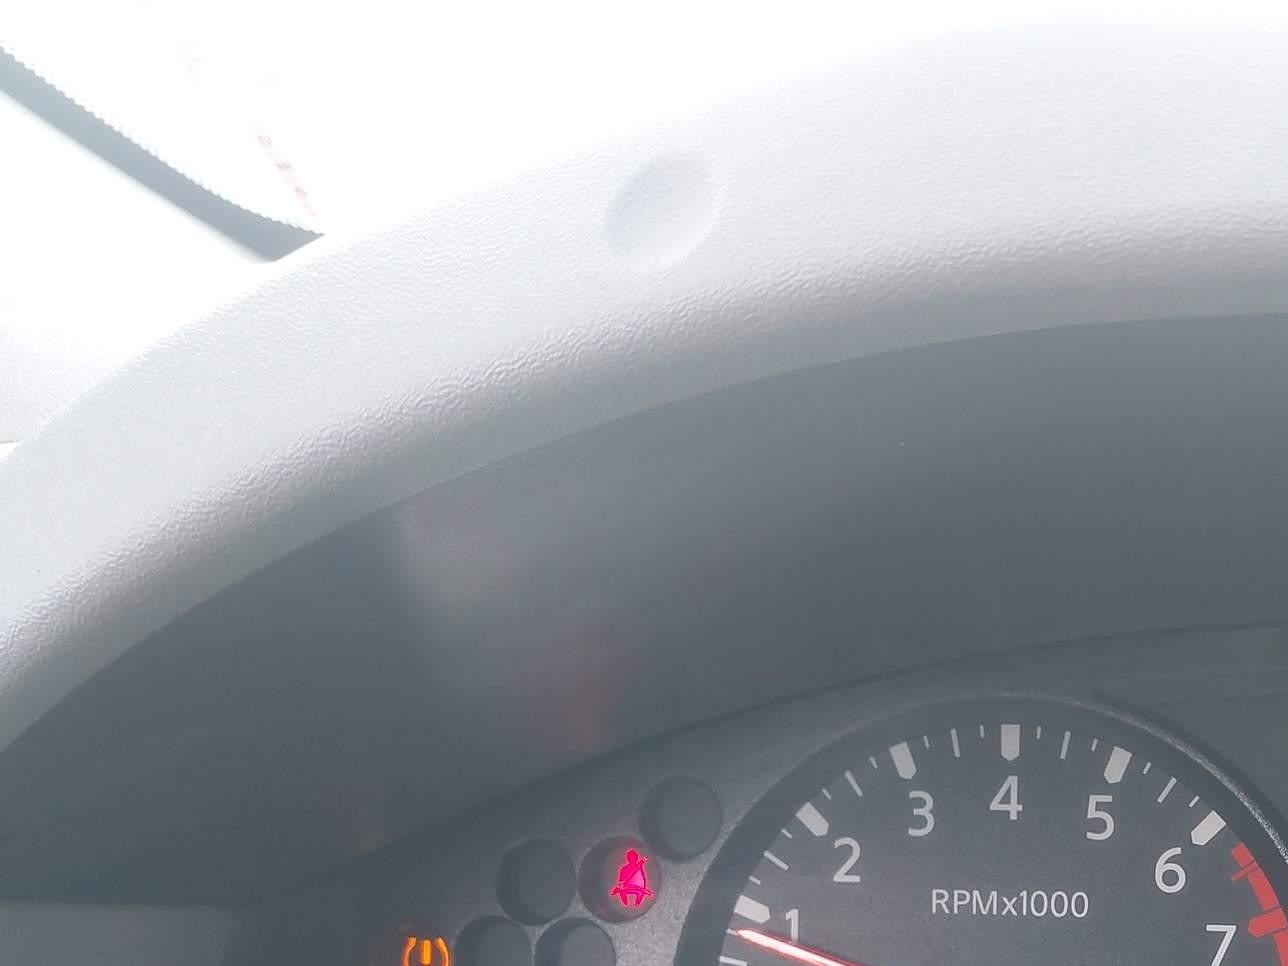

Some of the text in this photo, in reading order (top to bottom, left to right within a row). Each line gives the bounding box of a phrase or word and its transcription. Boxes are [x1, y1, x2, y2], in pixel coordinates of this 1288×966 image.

[907, 790, 935, 837] 3
[989, 775, 1023, 821] 4
[1086, 794, 1115, 841] 5
[832, 837, 861, 883] 2
[1154, 847, 1186, 894] 6
[785, 908, 799, 943] 1
[932, 889, 1091, 918] RPMx1000
